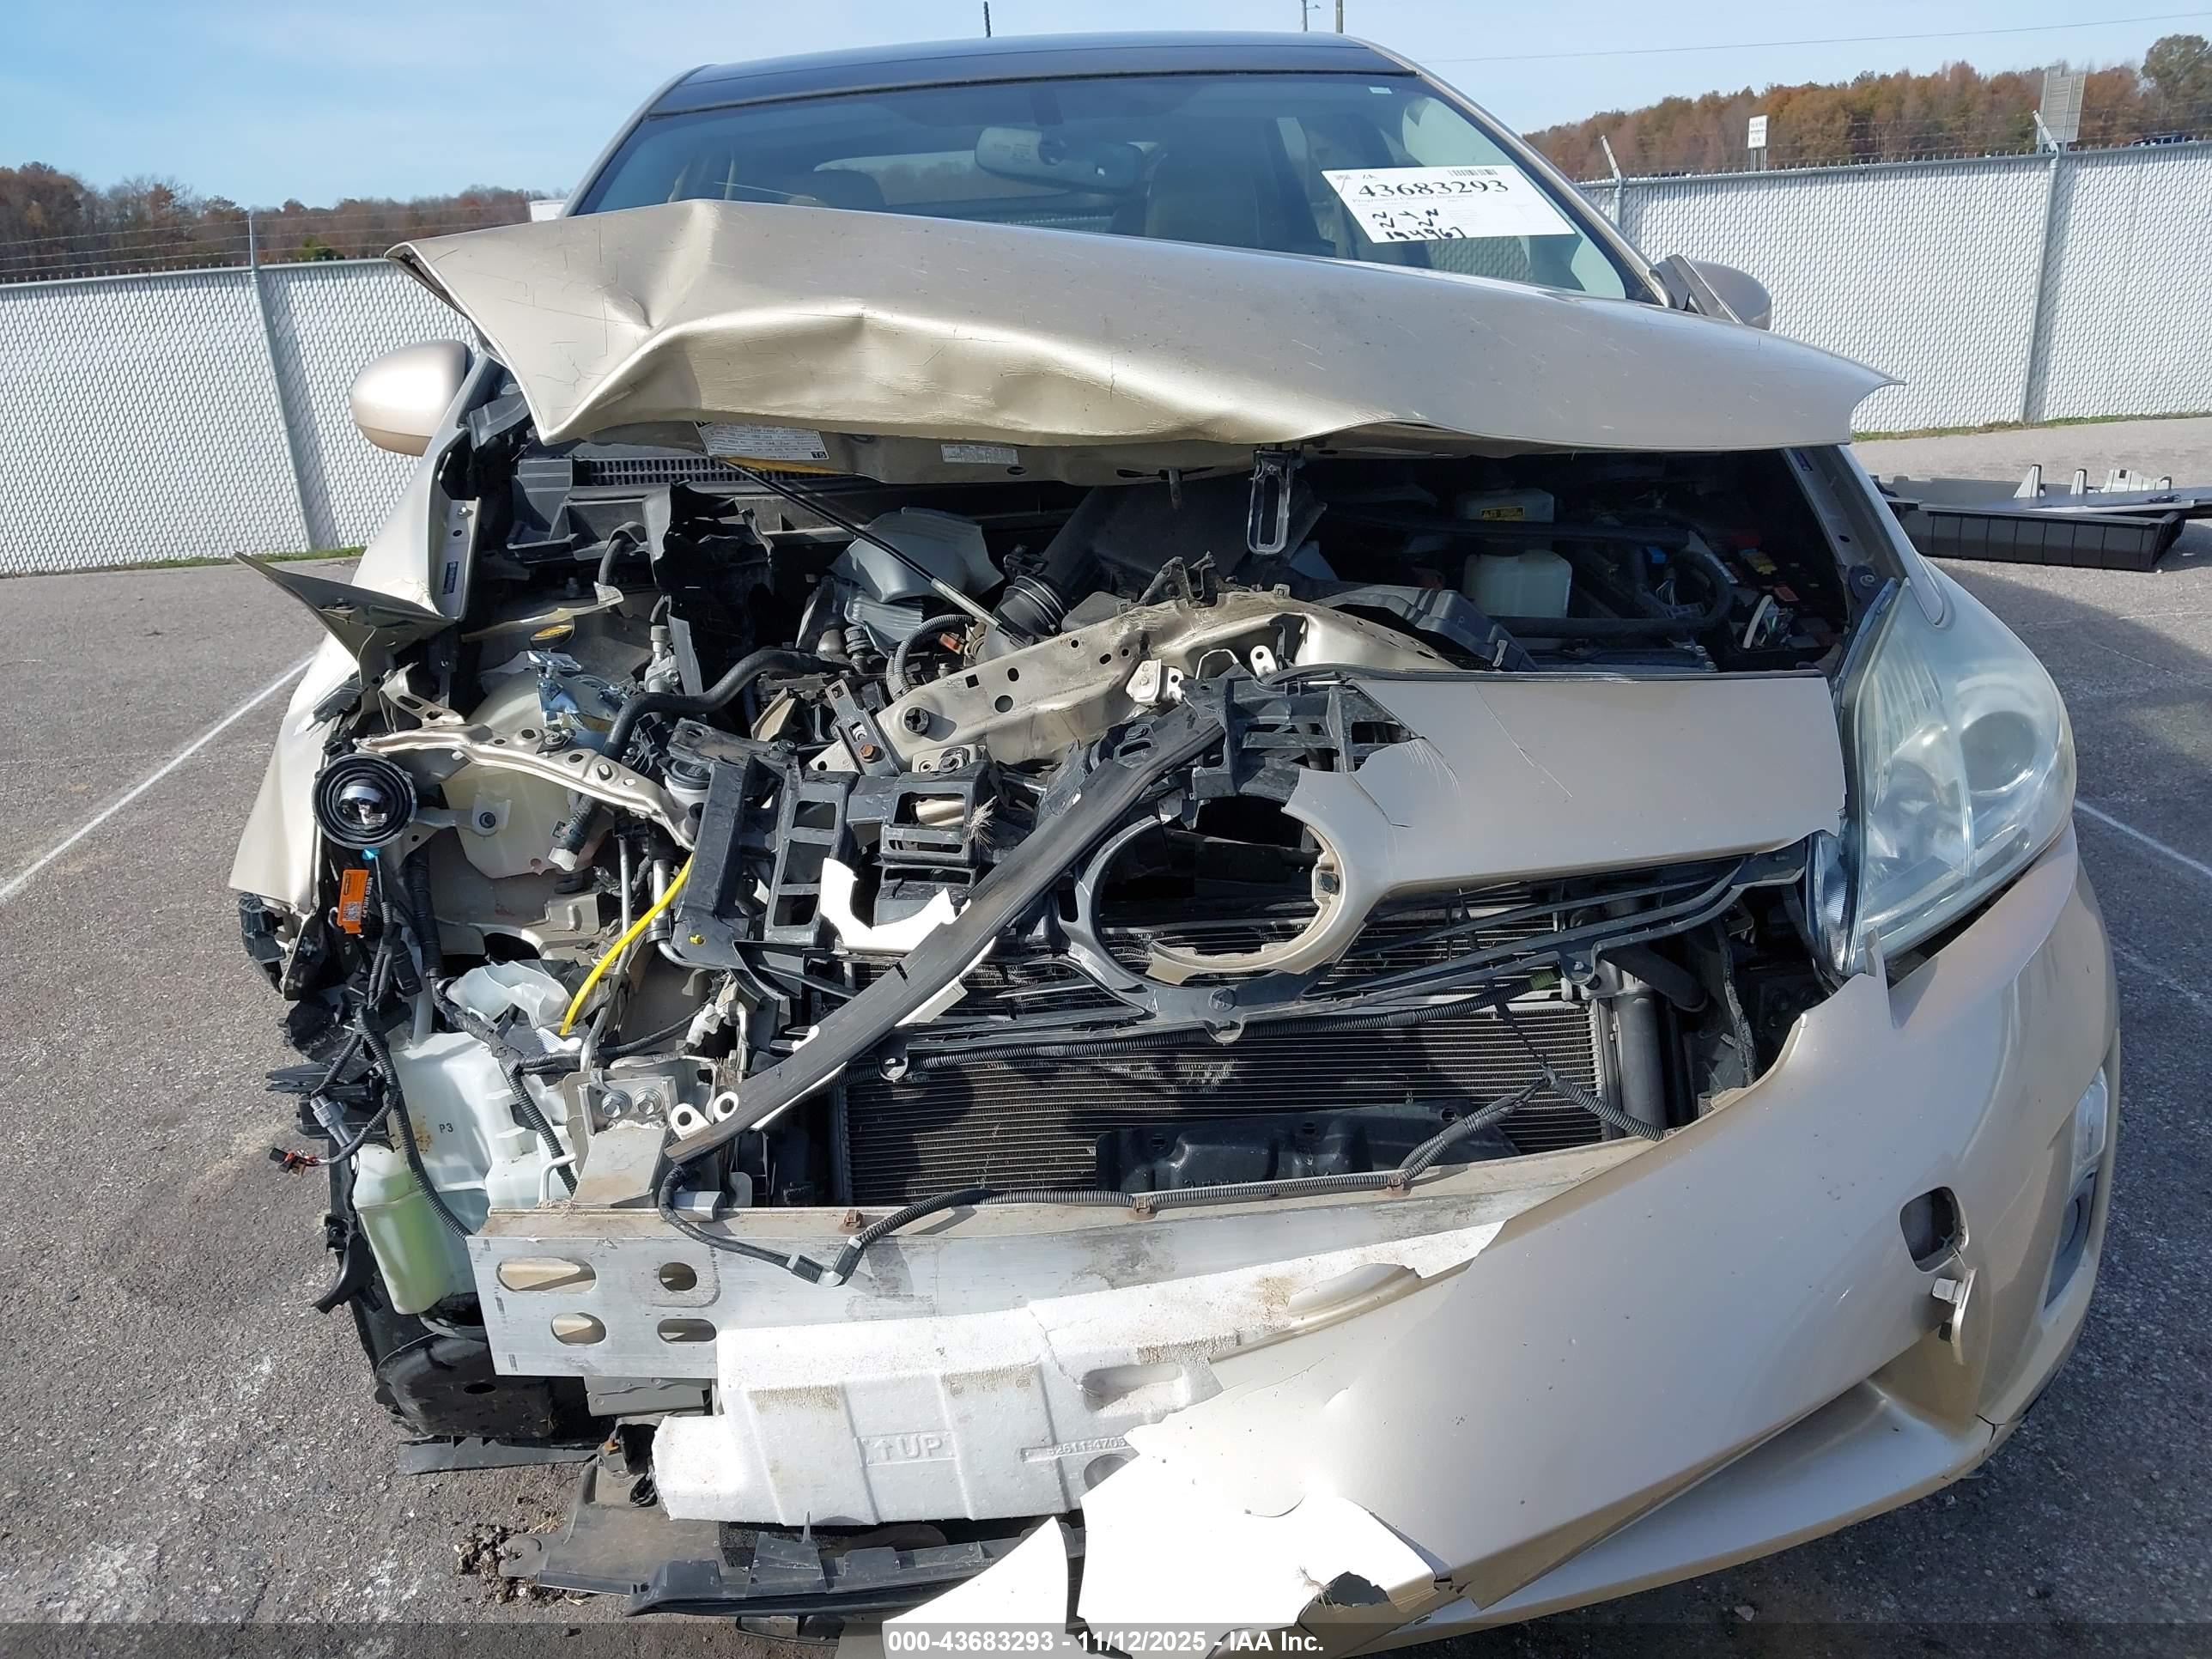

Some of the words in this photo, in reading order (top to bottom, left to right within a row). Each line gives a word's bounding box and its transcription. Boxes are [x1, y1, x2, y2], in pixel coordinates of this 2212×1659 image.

[1358, 179, 1509, 198] 43683293
[439, 1122, 453, 1133] P3
[897, 1432, 943, 1460] UP
